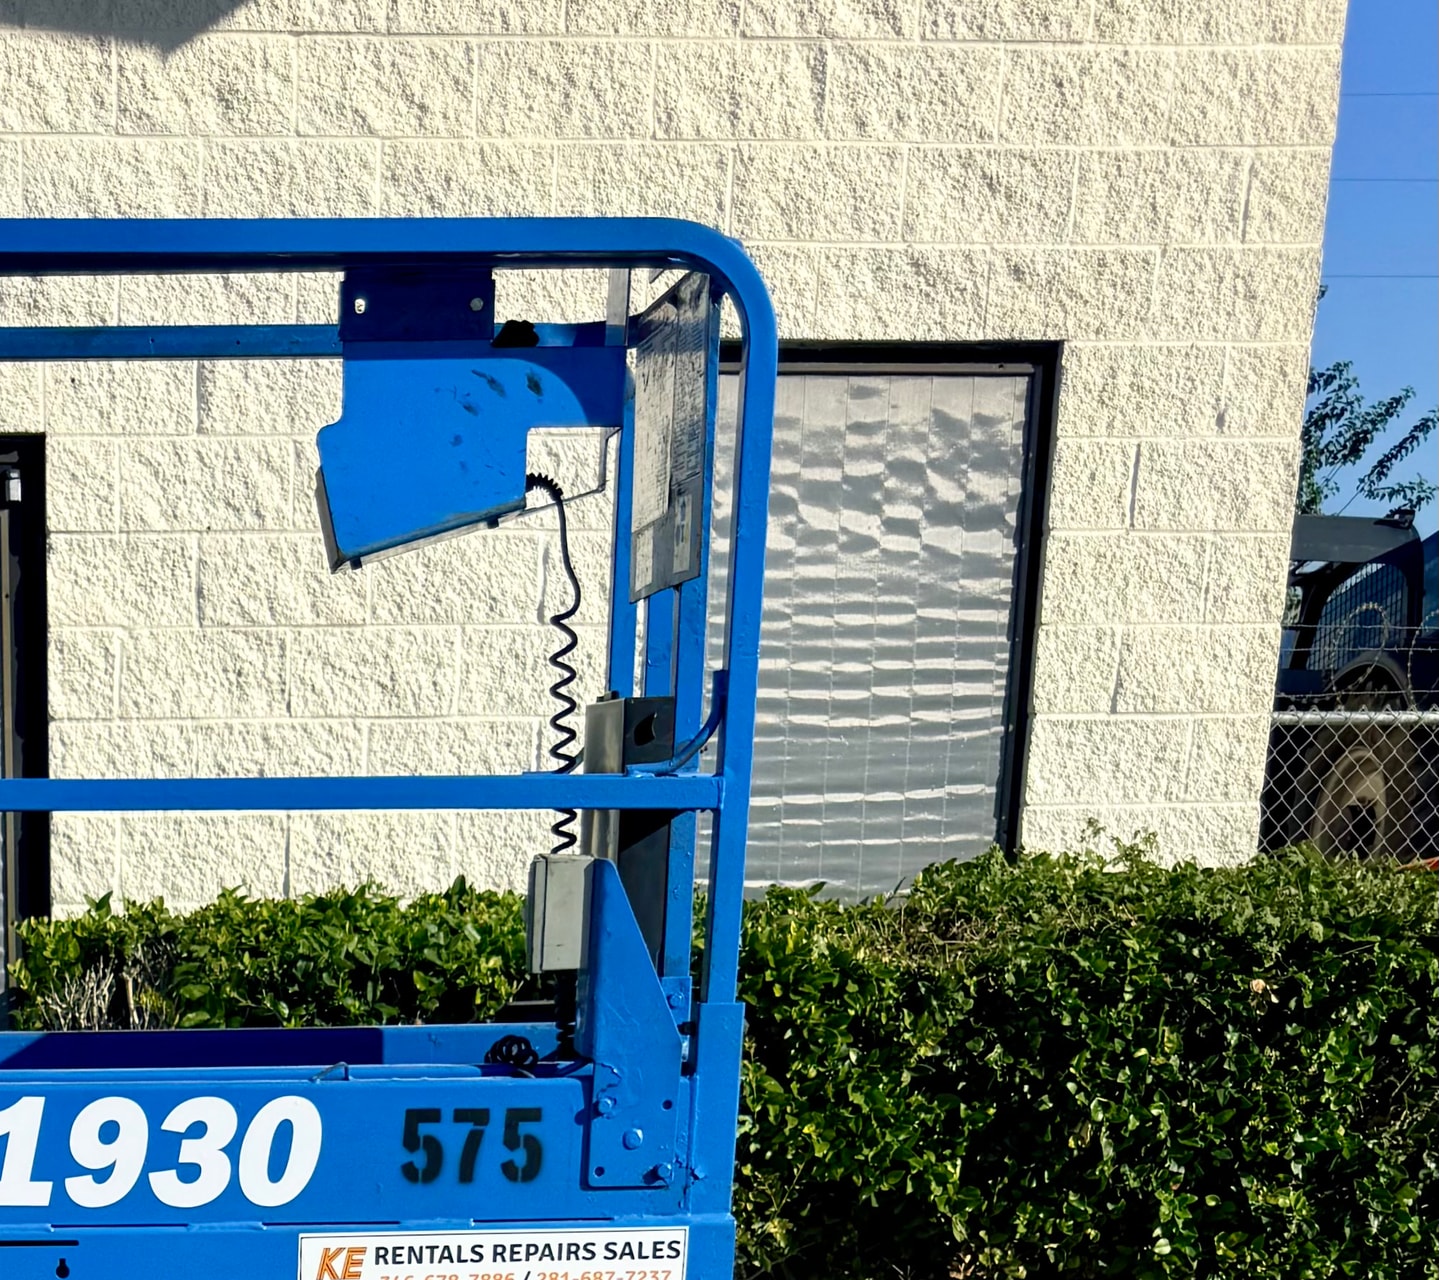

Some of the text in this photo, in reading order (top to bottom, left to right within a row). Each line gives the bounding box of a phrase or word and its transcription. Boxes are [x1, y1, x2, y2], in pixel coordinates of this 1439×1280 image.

[400, 1107, 544, 1184] 575
[315, 1246, 367, 1280] KE
[374, 1239, 682, 1266] RENTALS REPAIRS SALES
